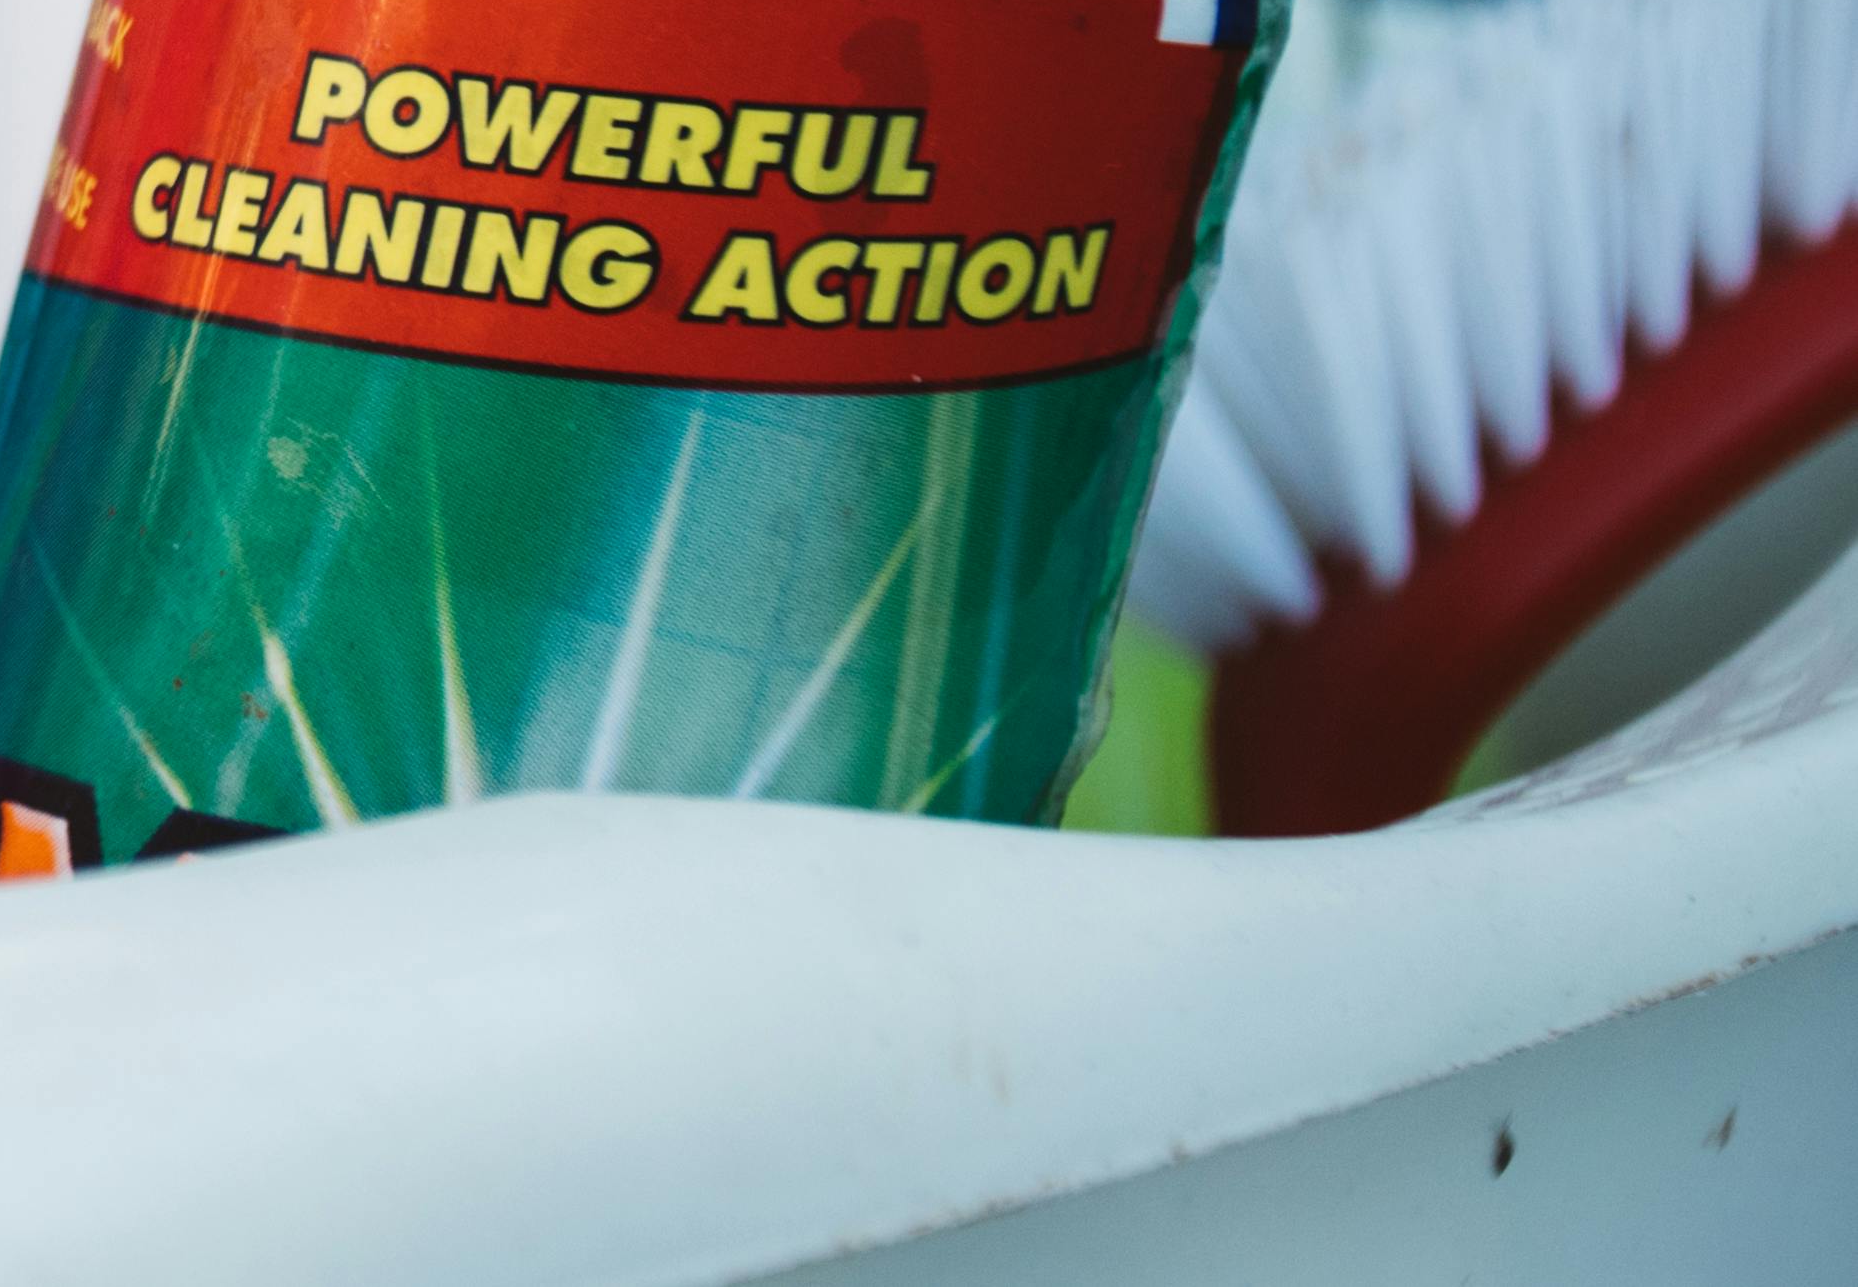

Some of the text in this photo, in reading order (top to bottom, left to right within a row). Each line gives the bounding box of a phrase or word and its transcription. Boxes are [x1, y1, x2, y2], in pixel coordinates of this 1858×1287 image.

[292, 52, 937, 203] POWERFUL
[130, 151, 1111, 327] CLEANING ACTION
